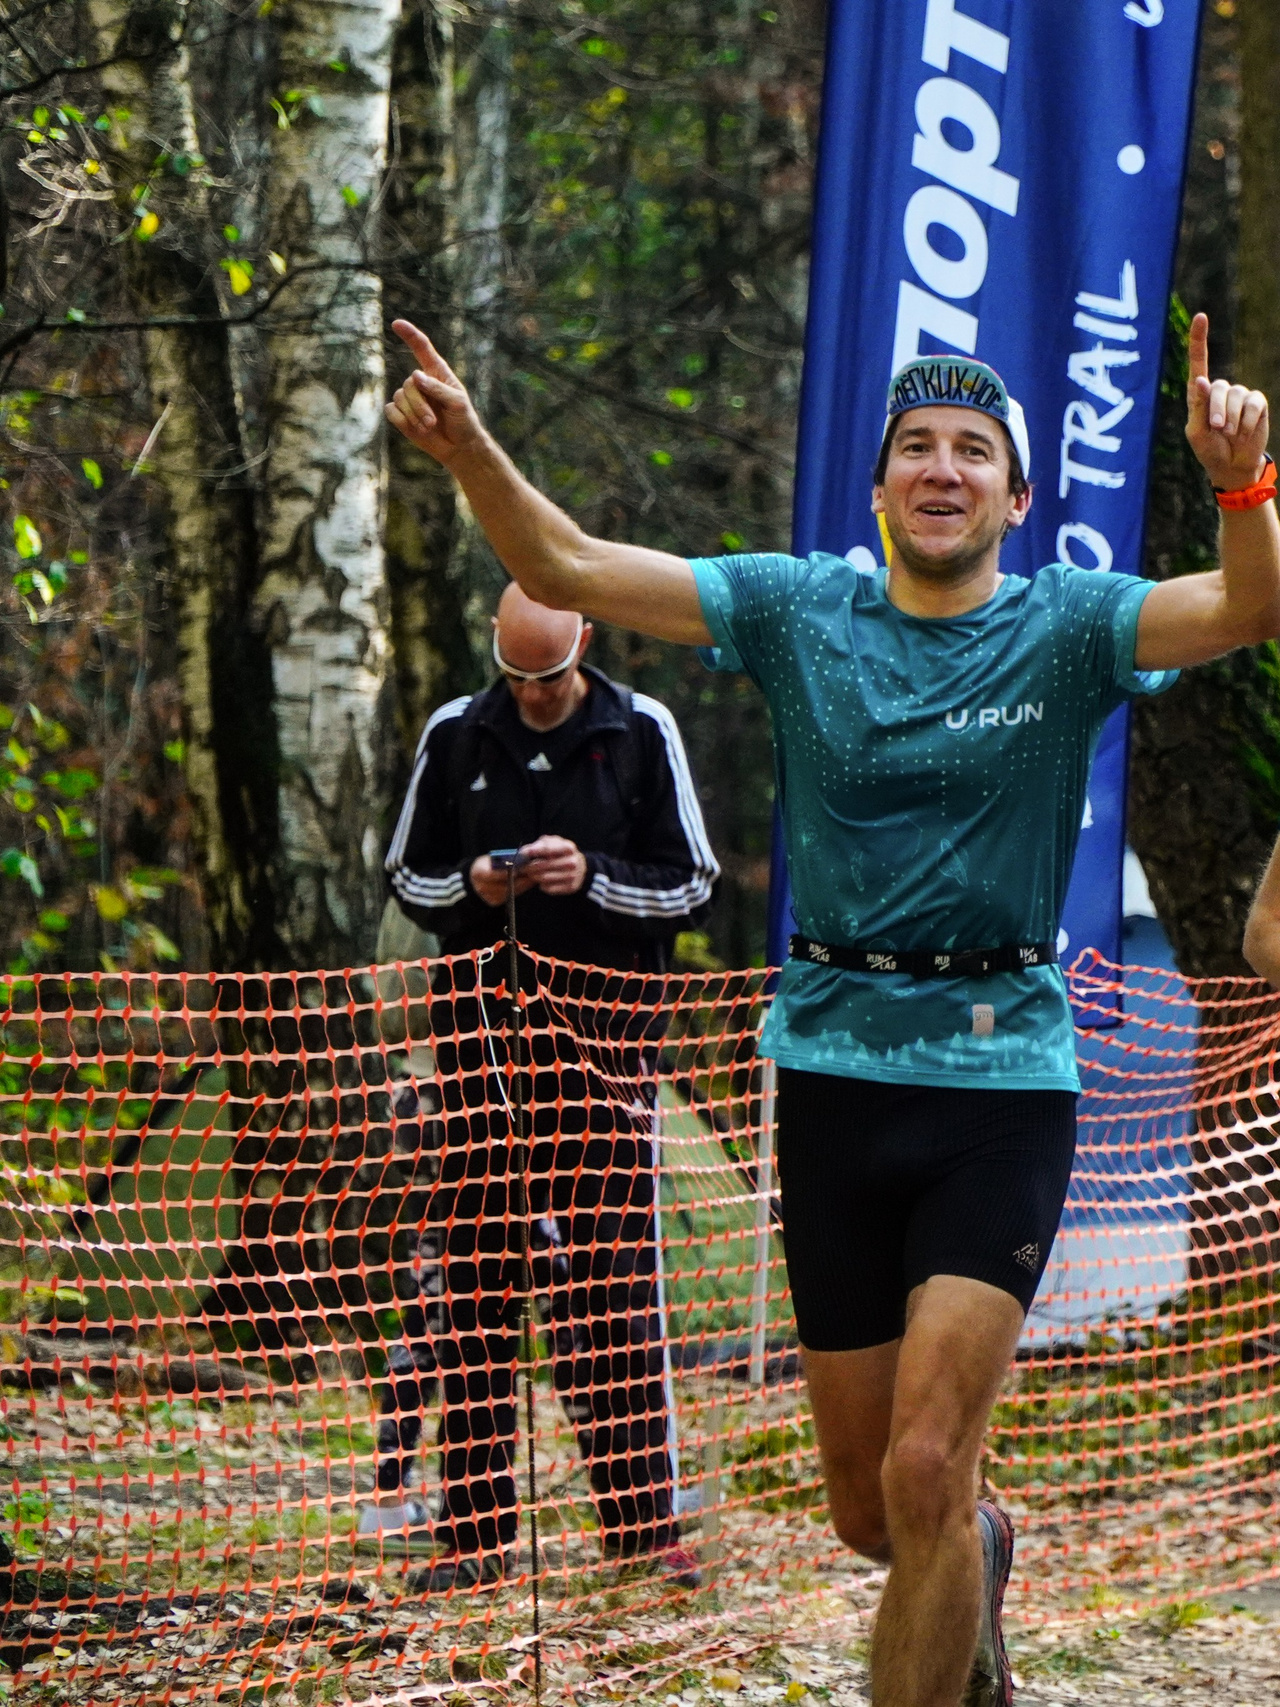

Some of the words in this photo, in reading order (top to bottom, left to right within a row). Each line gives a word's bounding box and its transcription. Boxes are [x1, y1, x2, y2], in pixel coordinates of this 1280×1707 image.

[891, 0, 1020, 378] порт
[1059, 258, 1141, 499] TRAIL
[978, 701, 1044, 729] RUN
[866, 953, 886, 965] RUN
[879, 960, 898, 971] LAB
